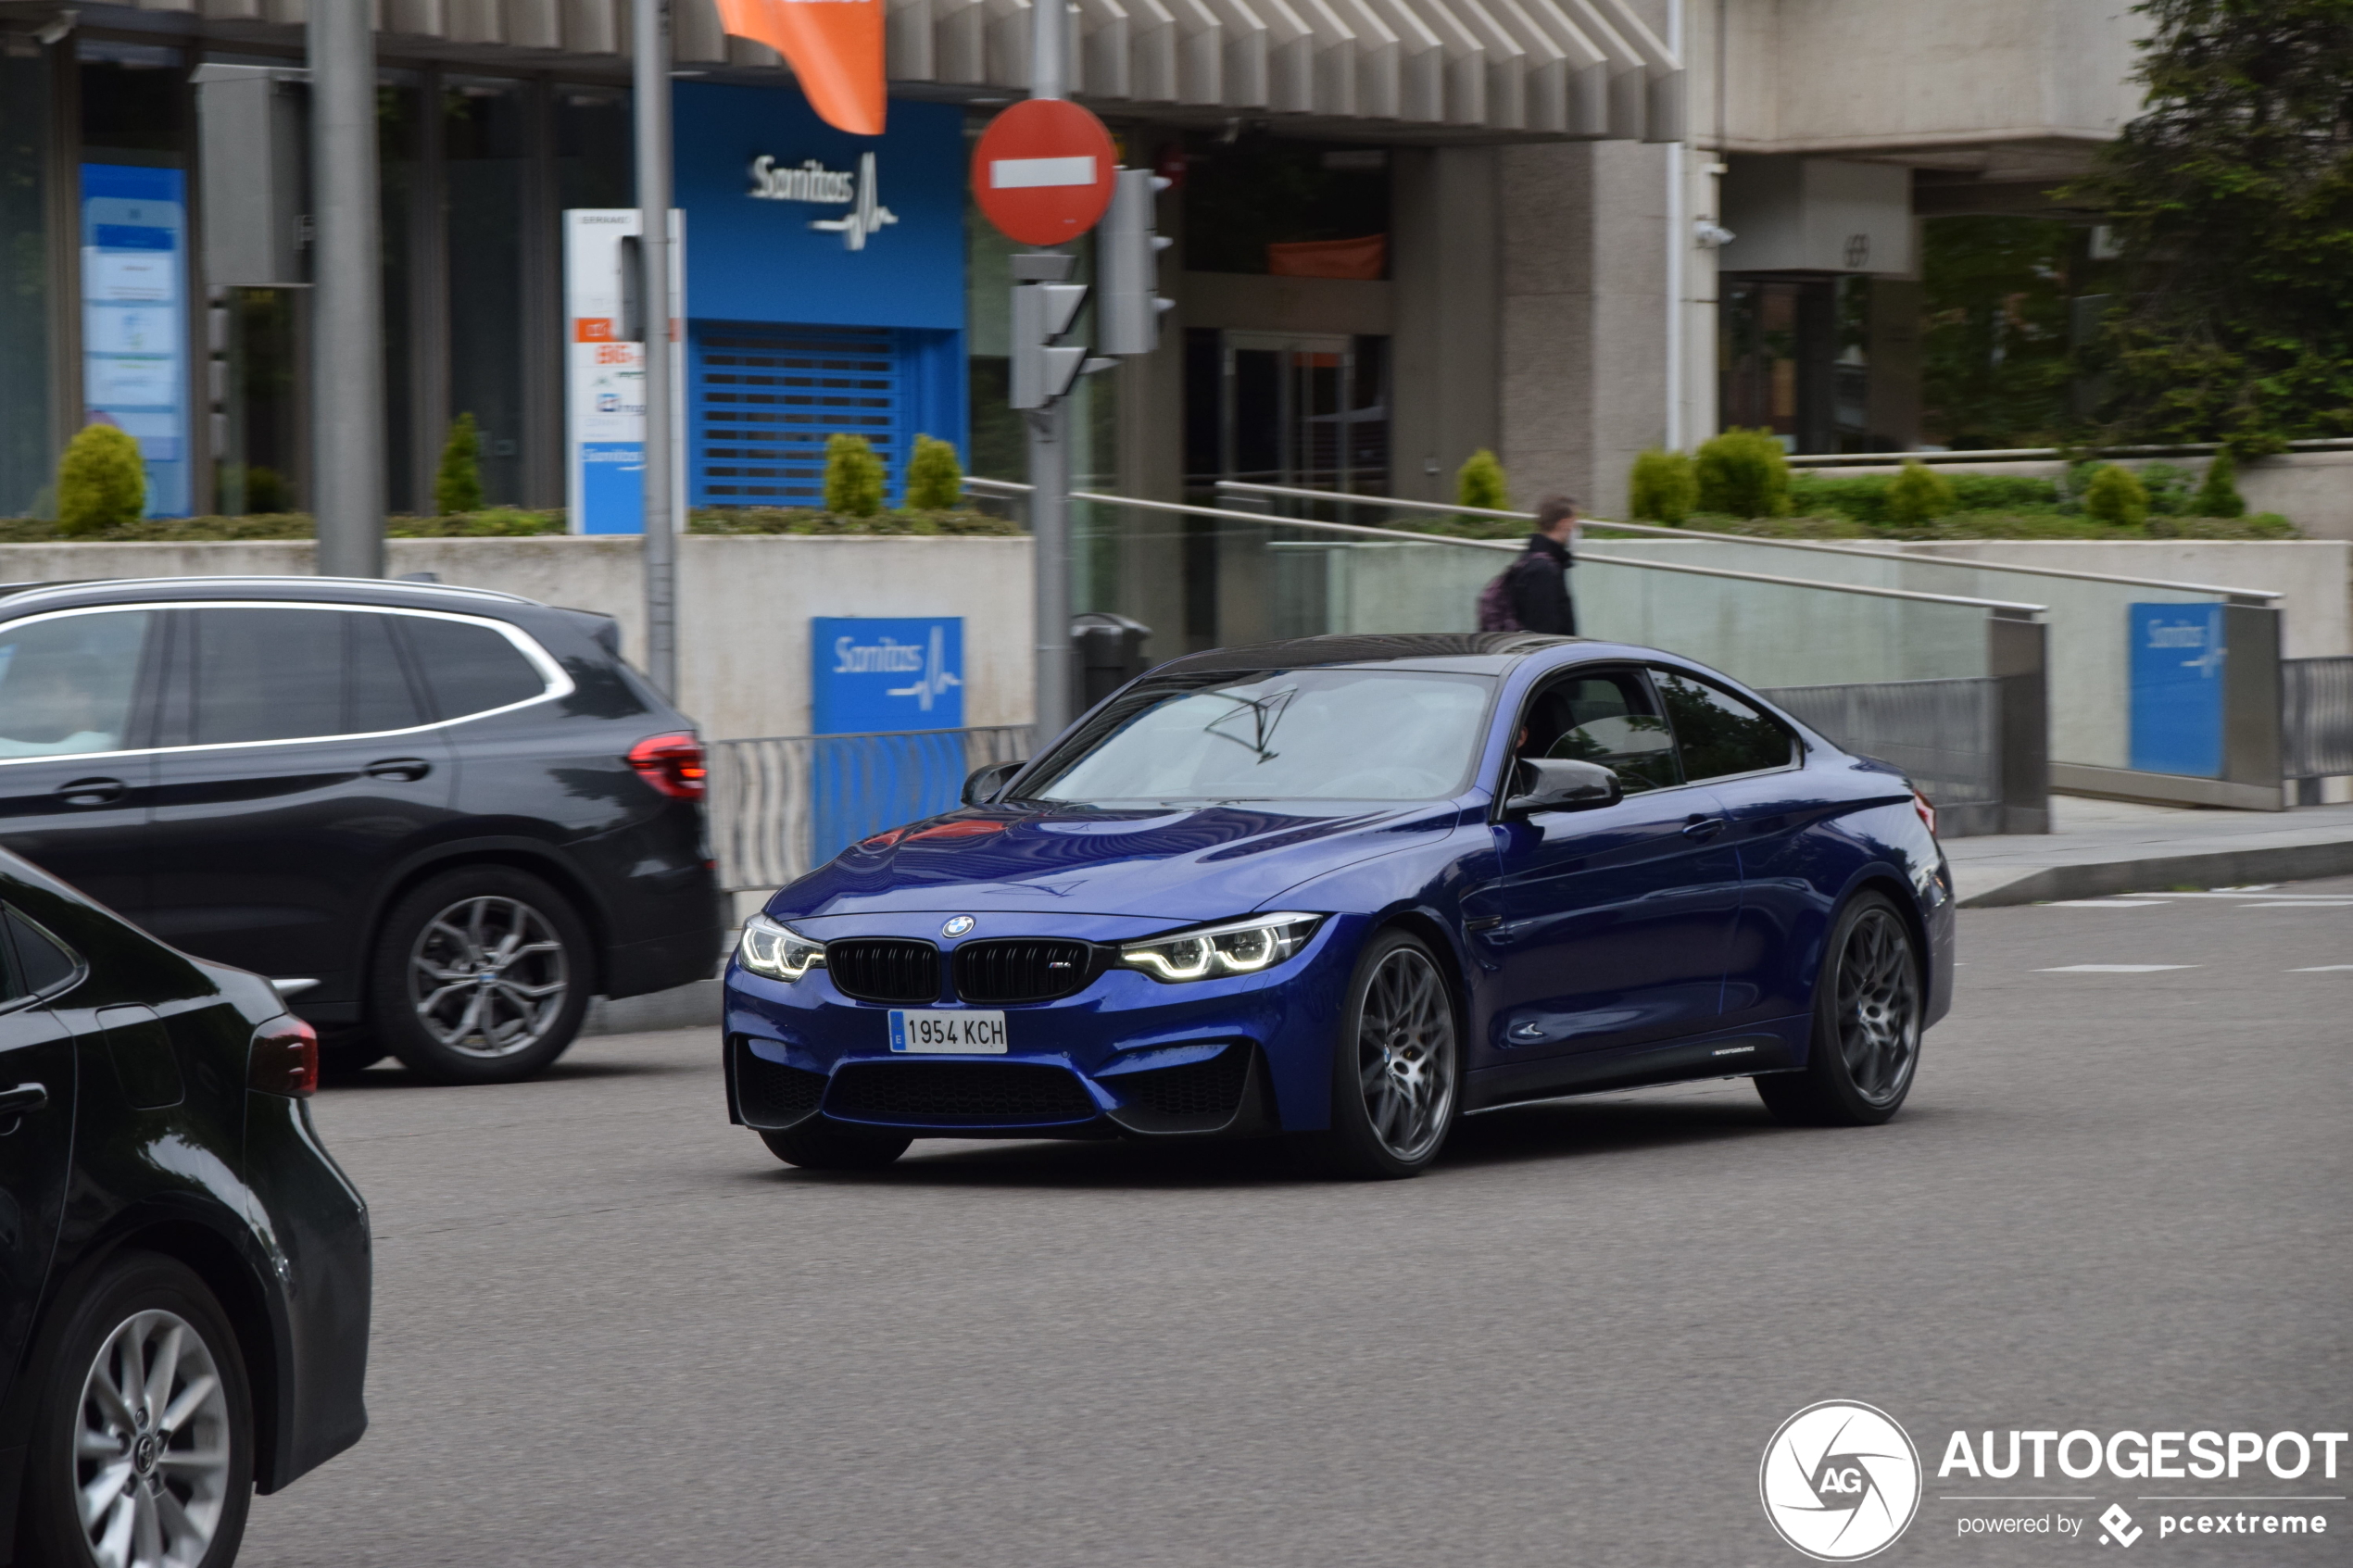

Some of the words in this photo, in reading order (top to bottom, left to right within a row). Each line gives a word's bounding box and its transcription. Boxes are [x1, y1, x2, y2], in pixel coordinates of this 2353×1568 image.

[747, 155, 854, 203] Sanitas
[834, 636, 924, 672] Sanitas
[895, 1035, 902, 1044] E
[909, 1020, 958, 1045] 1954
[964, 1021, 1004, 1045] KCH
